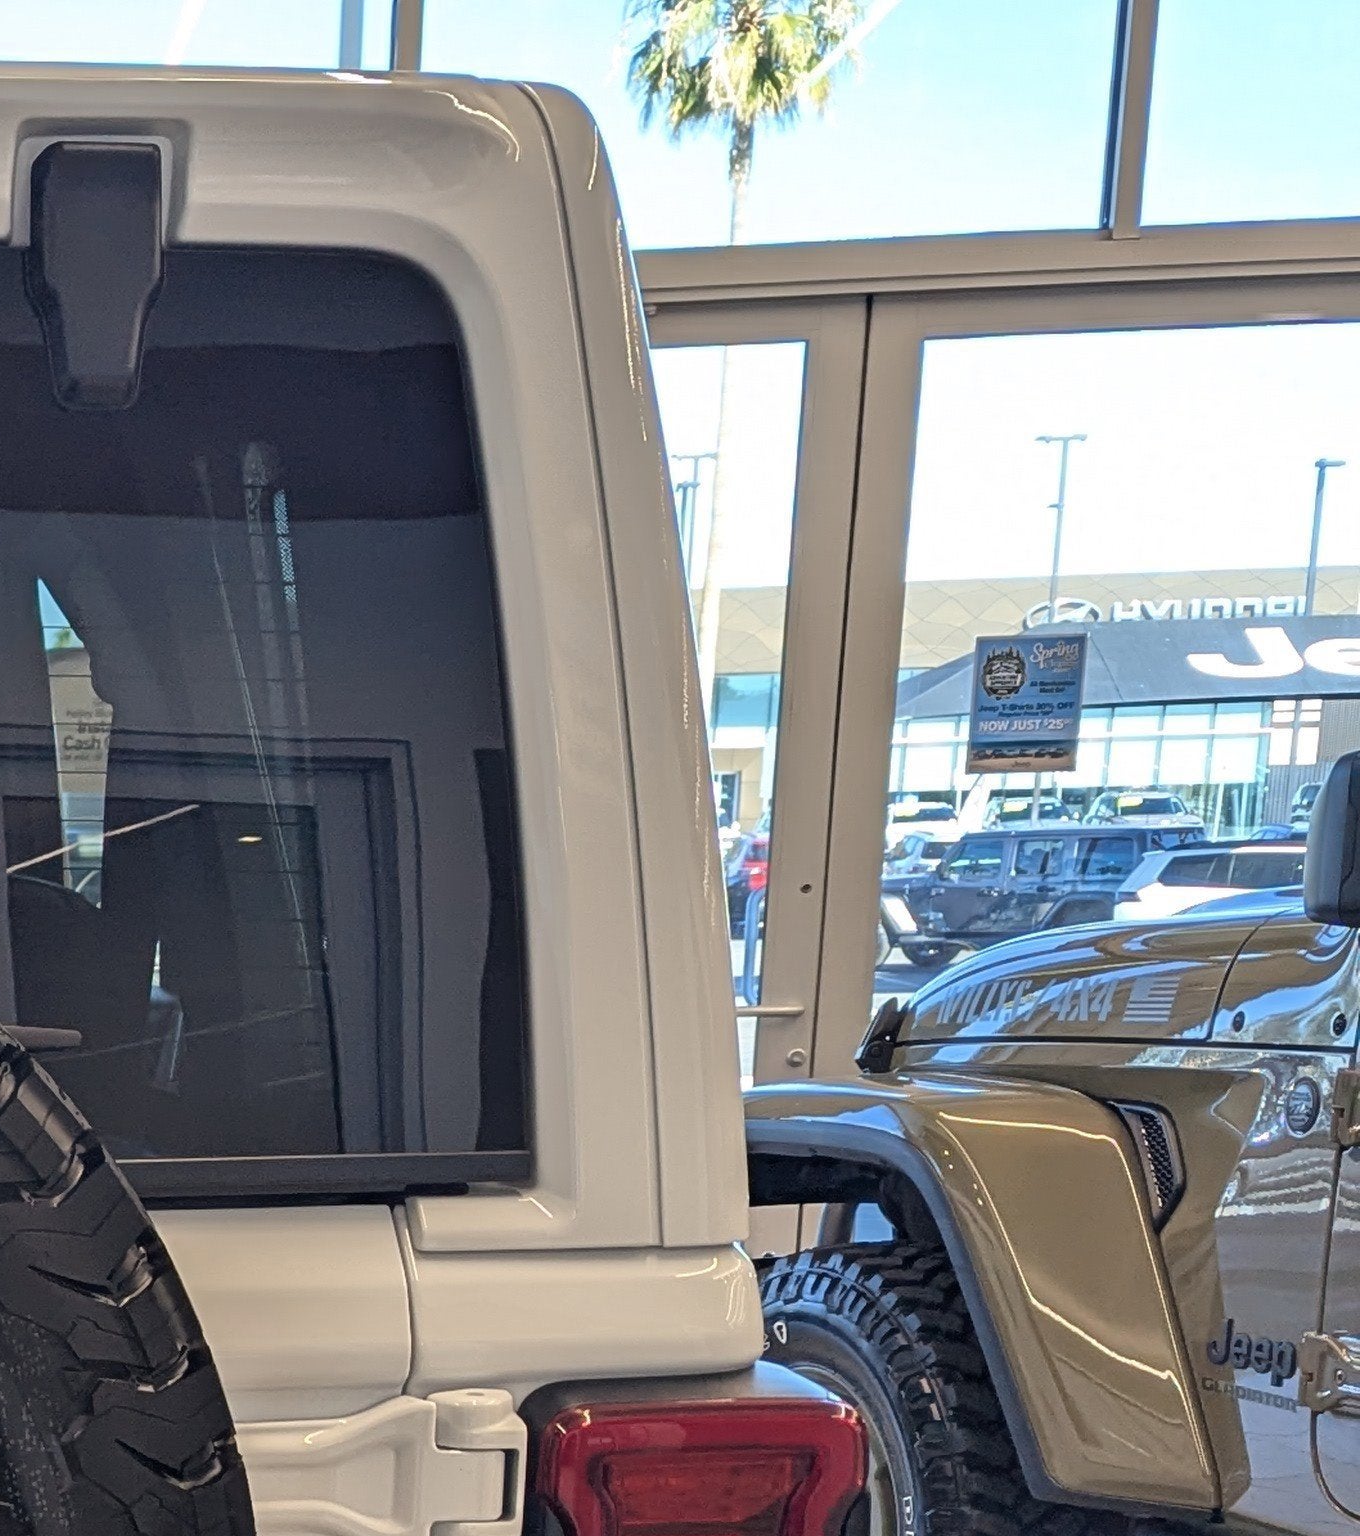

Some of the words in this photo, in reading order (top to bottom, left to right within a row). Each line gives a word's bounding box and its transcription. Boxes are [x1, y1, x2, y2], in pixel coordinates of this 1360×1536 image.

[1111, 595, 1307, 621] HYUNDAI
[1030, 641, 1079, 669] Spring
[1187, 627, 1360, 679] Je
[979, 720, 1009, 732] NOW
[1011, 719, 1041, 731] JUST
[1207, 1318, 1297, 1387] Jeep
[1202, 1376, 1298, 1413] GLADIATOR
